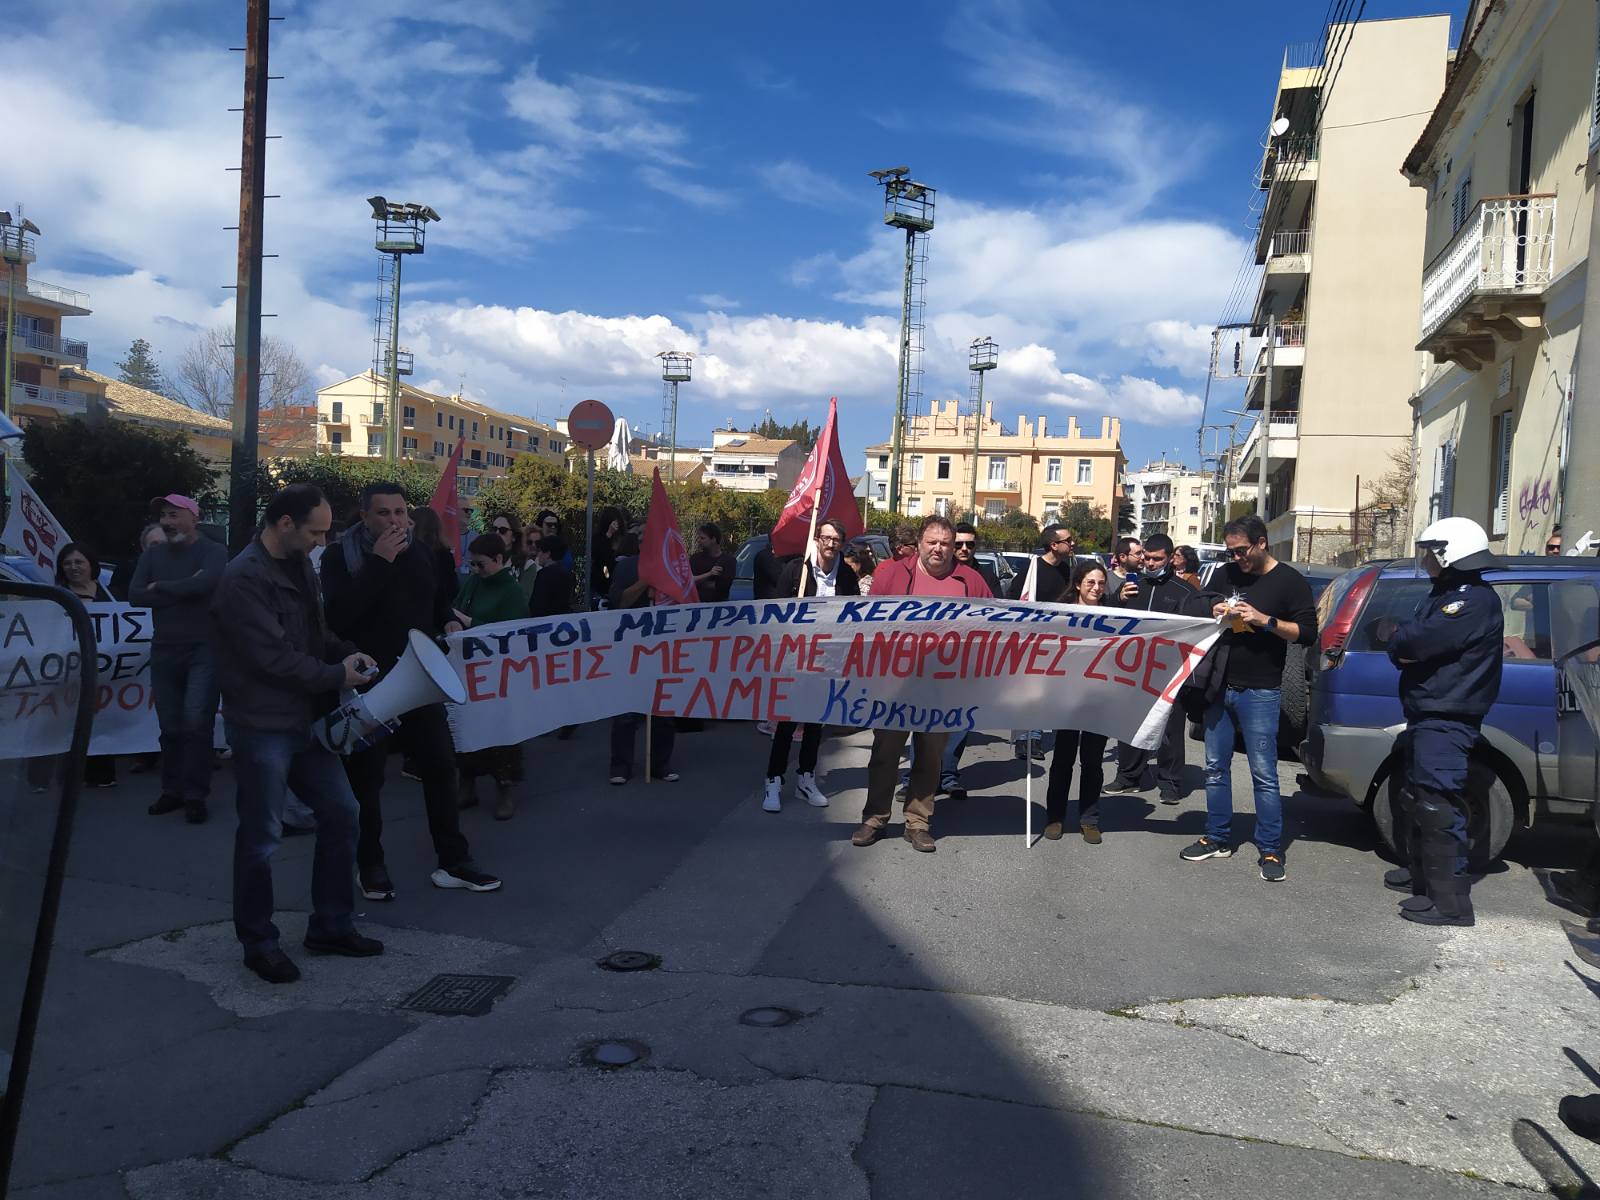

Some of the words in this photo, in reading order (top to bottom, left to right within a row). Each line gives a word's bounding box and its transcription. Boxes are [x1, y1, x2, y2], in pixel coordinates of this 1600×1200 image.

[462, 618, 592, 660] ΑΥΤΟΙ
[614, 602, 827, 642] ΜΕΤΡΑΝΕ
[836, 601, 971, 623] ΚΕΡΔΗ
[465, 645, 612, 702] ΕΜΕΙΣ
[629, 633, 832, 675] ΜΕΤΡΑΜΕ
[652, 677, 796, 722] ΕΛΜΕ
